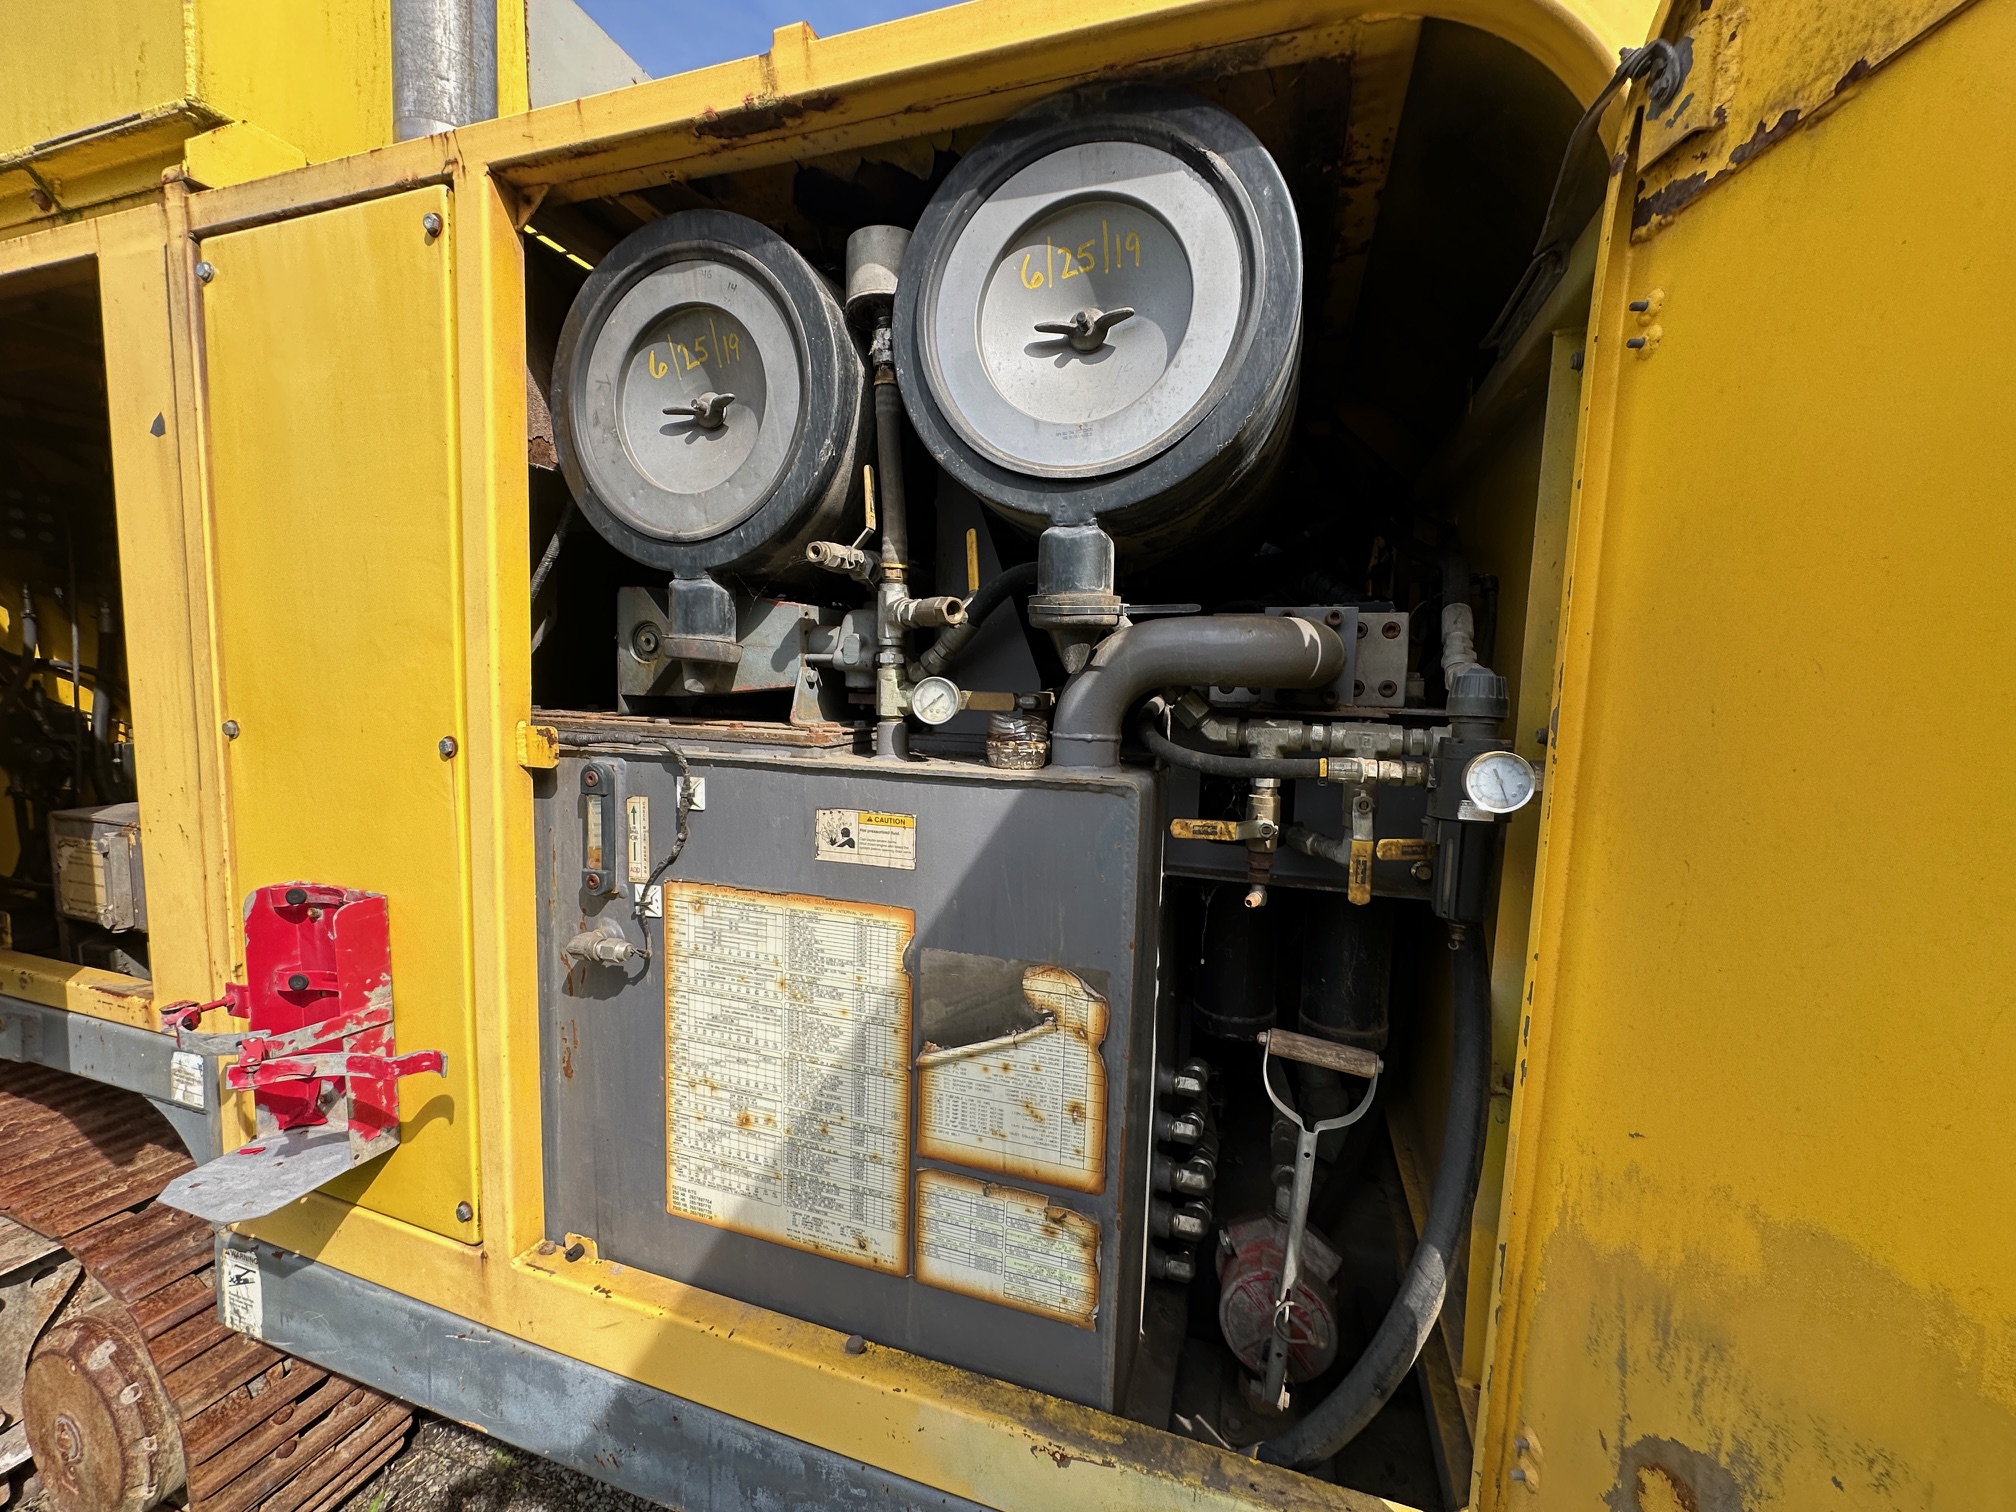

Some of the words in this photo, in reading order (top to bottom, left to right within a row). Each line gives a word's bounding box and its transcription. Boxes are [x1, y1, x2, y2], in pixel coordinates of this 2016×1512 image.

[1020, 219, 1141, 290] 6/25/19
[727, 281, 738, 292] 14
[648, 318, 740, 381] 6/25/19
[874, 816, 906, 826] CAUTION
[230, 1249, 259, 1264] WARNING
